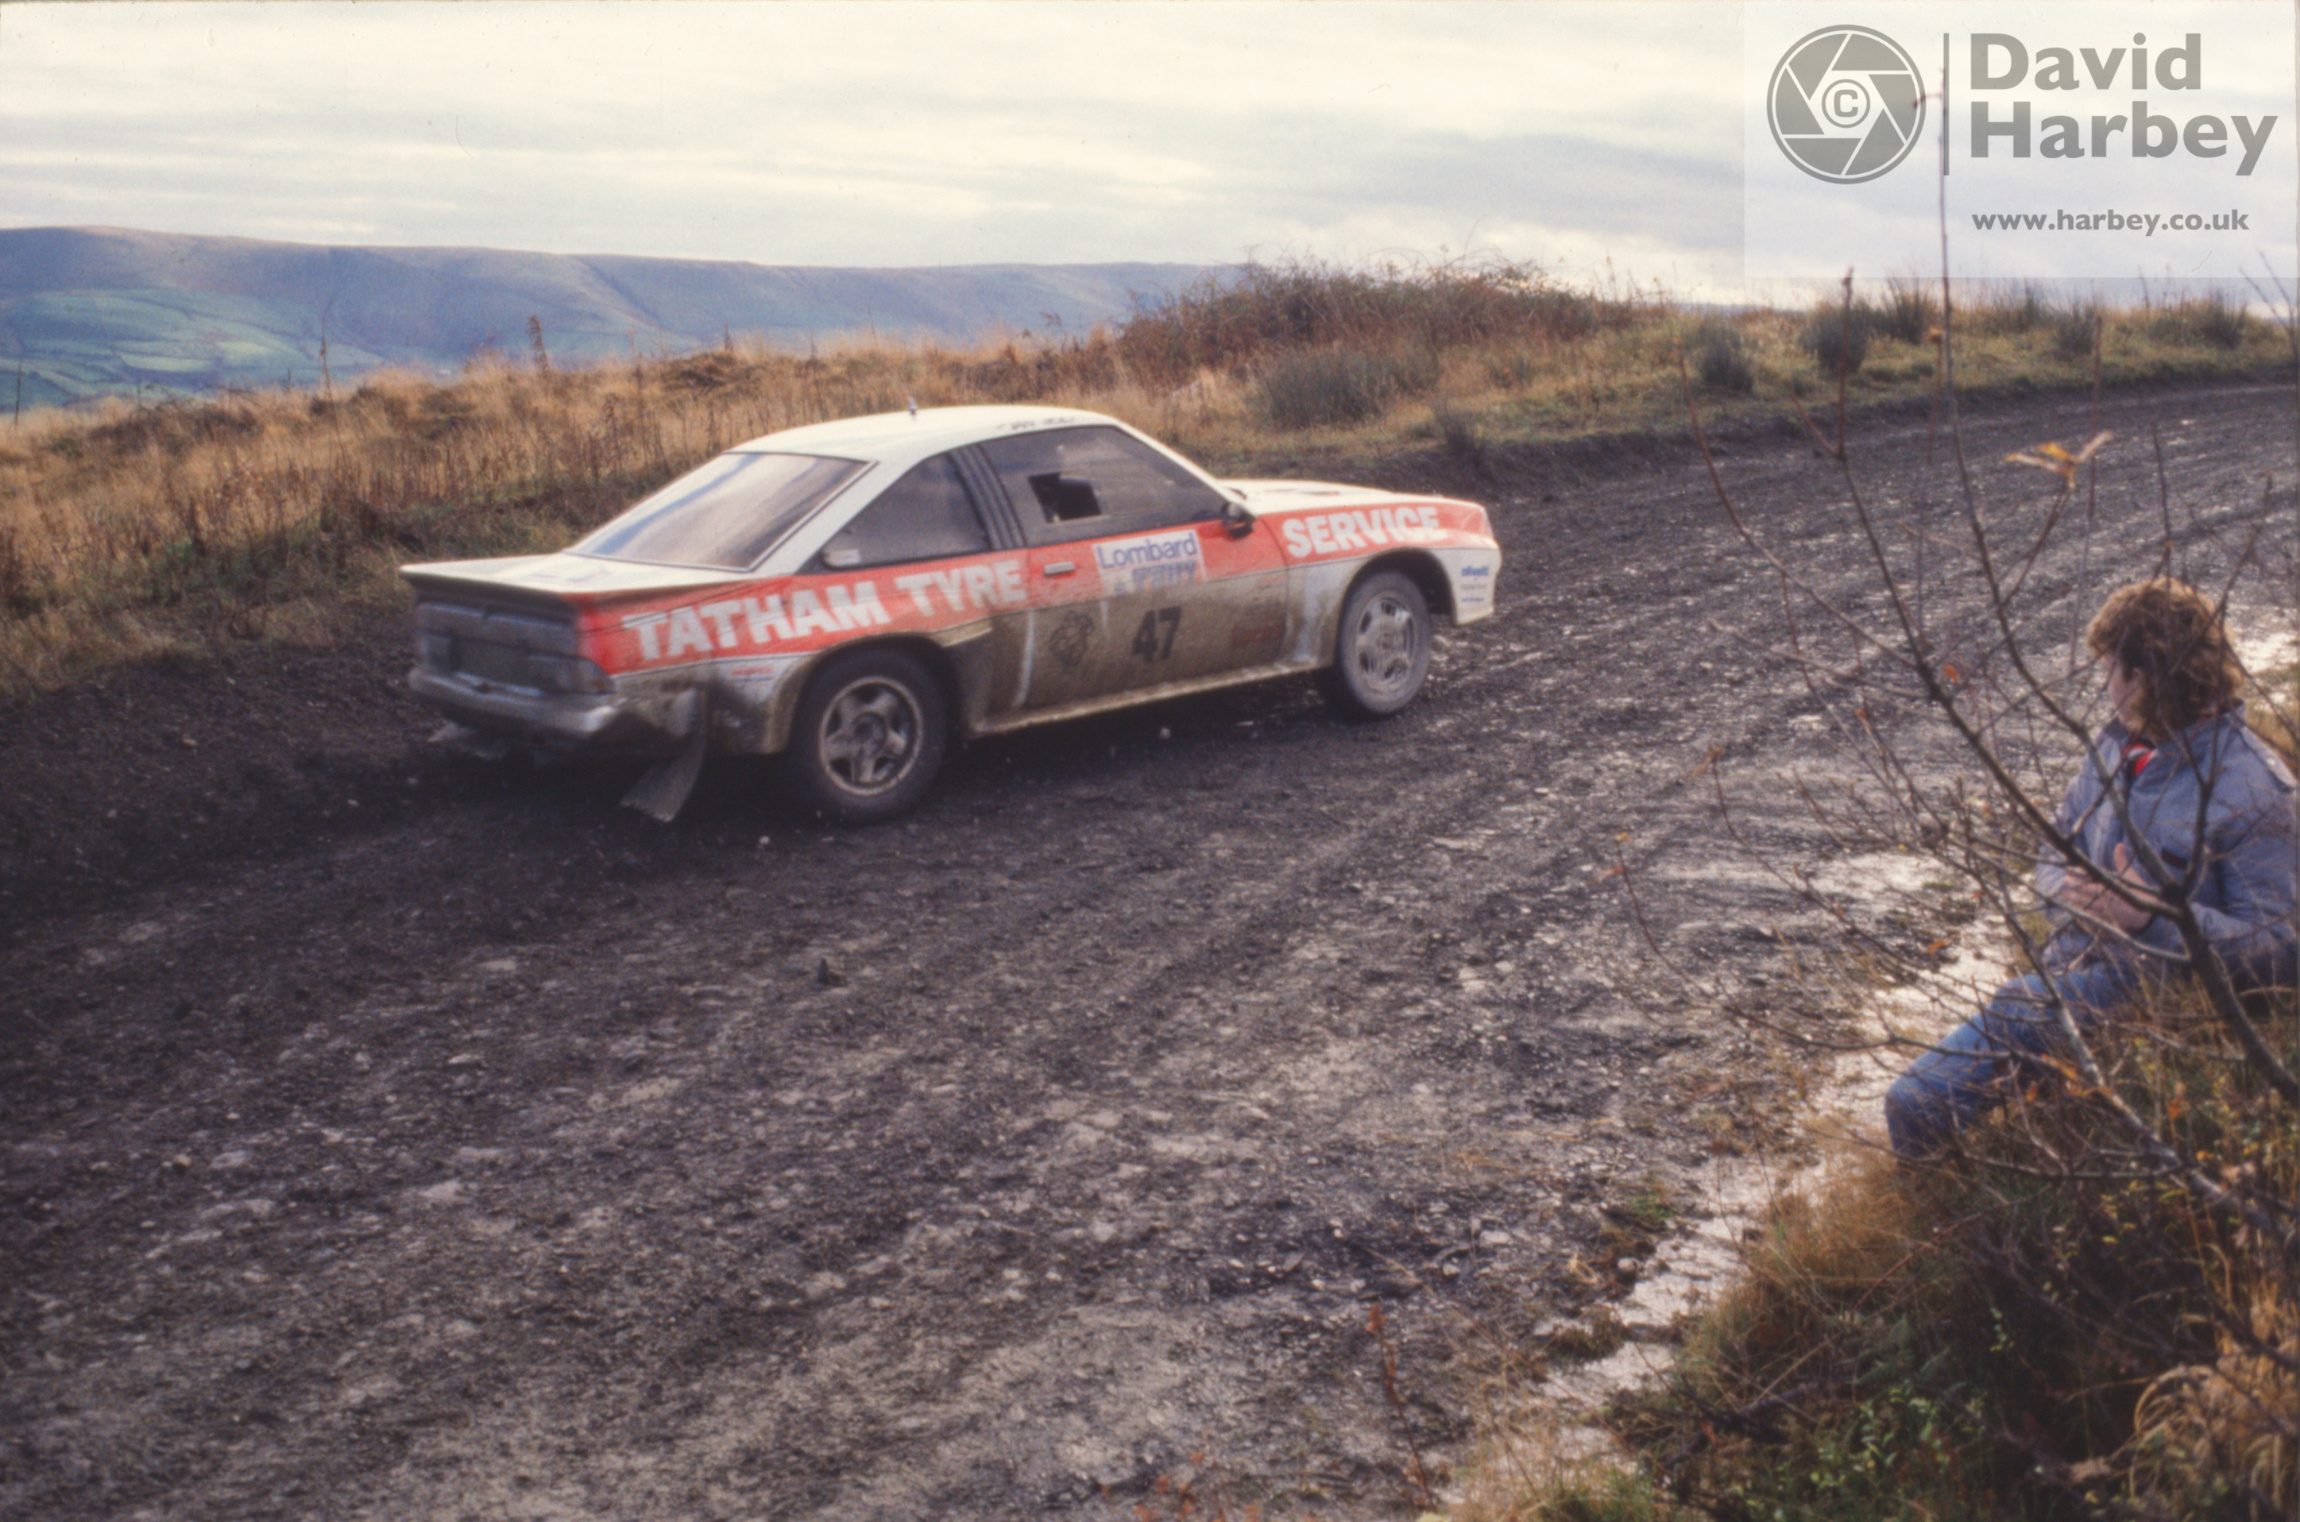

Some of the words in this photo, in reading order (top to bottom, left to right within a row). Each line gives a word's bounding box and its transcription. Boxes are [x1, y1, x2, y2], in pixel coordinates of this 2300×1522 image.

[1097, 532, 1198, 569] Lombard
[622, 580, 891, 661] TATHAM
[895, 560, 1028, 617] TYRE
[1282, 506, 1448, 559] SERVICE
[1131, 605, 1182, 664] 47
